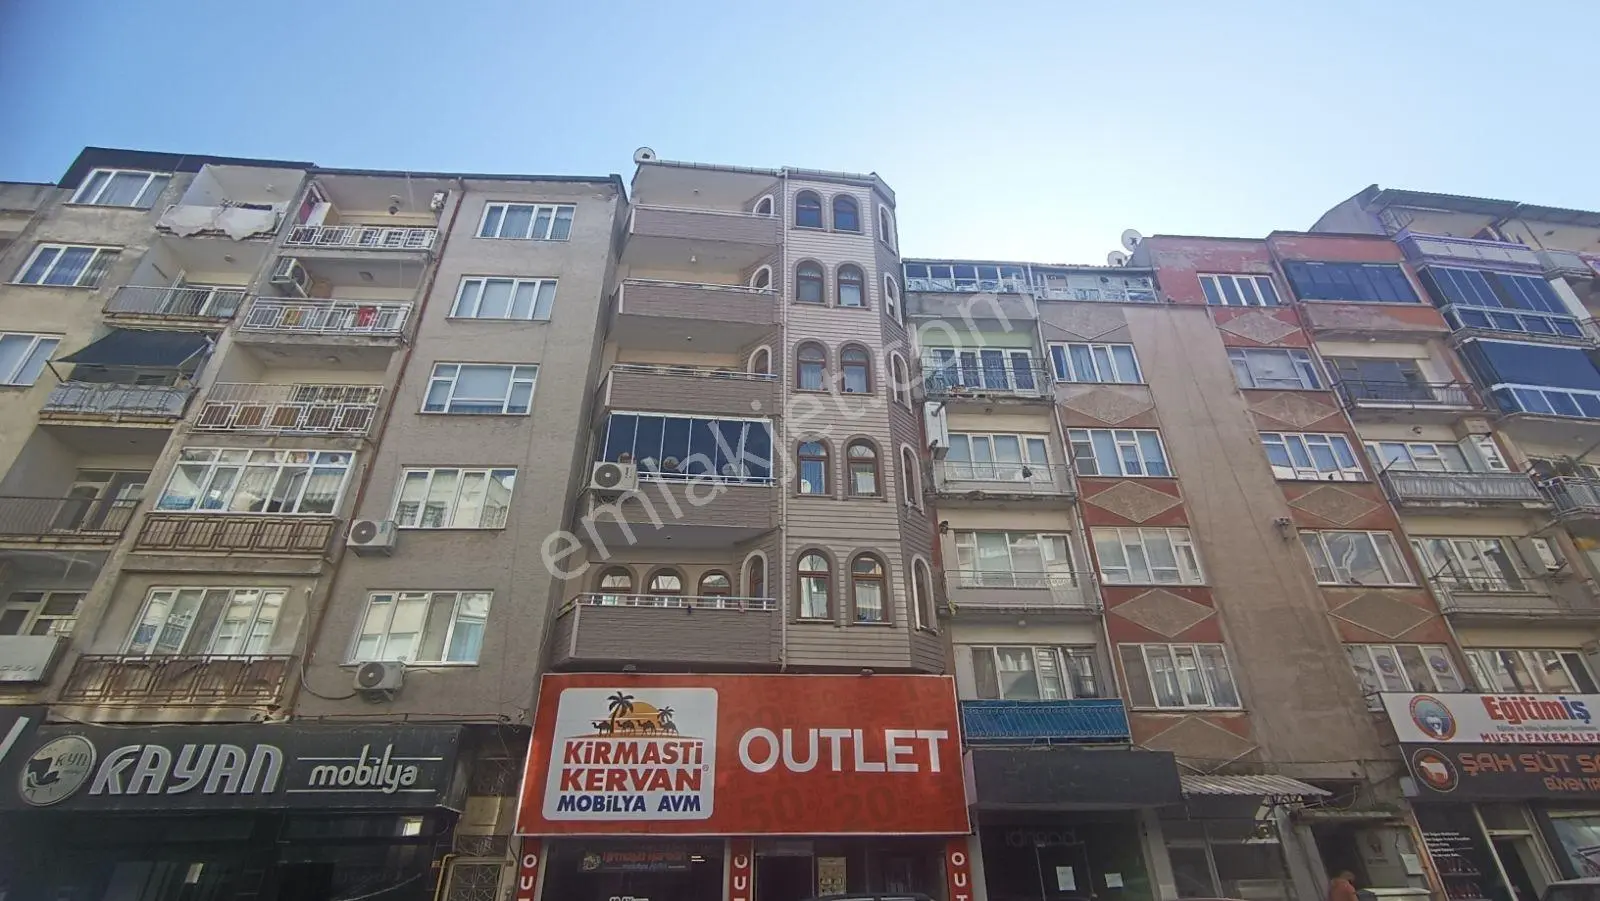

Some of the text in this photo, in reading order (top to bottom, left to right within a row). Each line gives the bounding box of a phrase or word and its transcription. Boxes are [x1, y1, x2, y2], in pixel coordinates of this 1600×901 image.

[88, 743, 418, 795] KAYAN mobilya
[738, 727, 948, 773] OUTLET
[1457, 752, 1517, 776] ŞAH
[1519, 751, 1570, 773] SÜT
[560, 768, 701, 791] KERVAN
[657, 795, 701, 812] AVM
[518, 853, 537, 901] OU
[734, 854, 748, 901] OU
